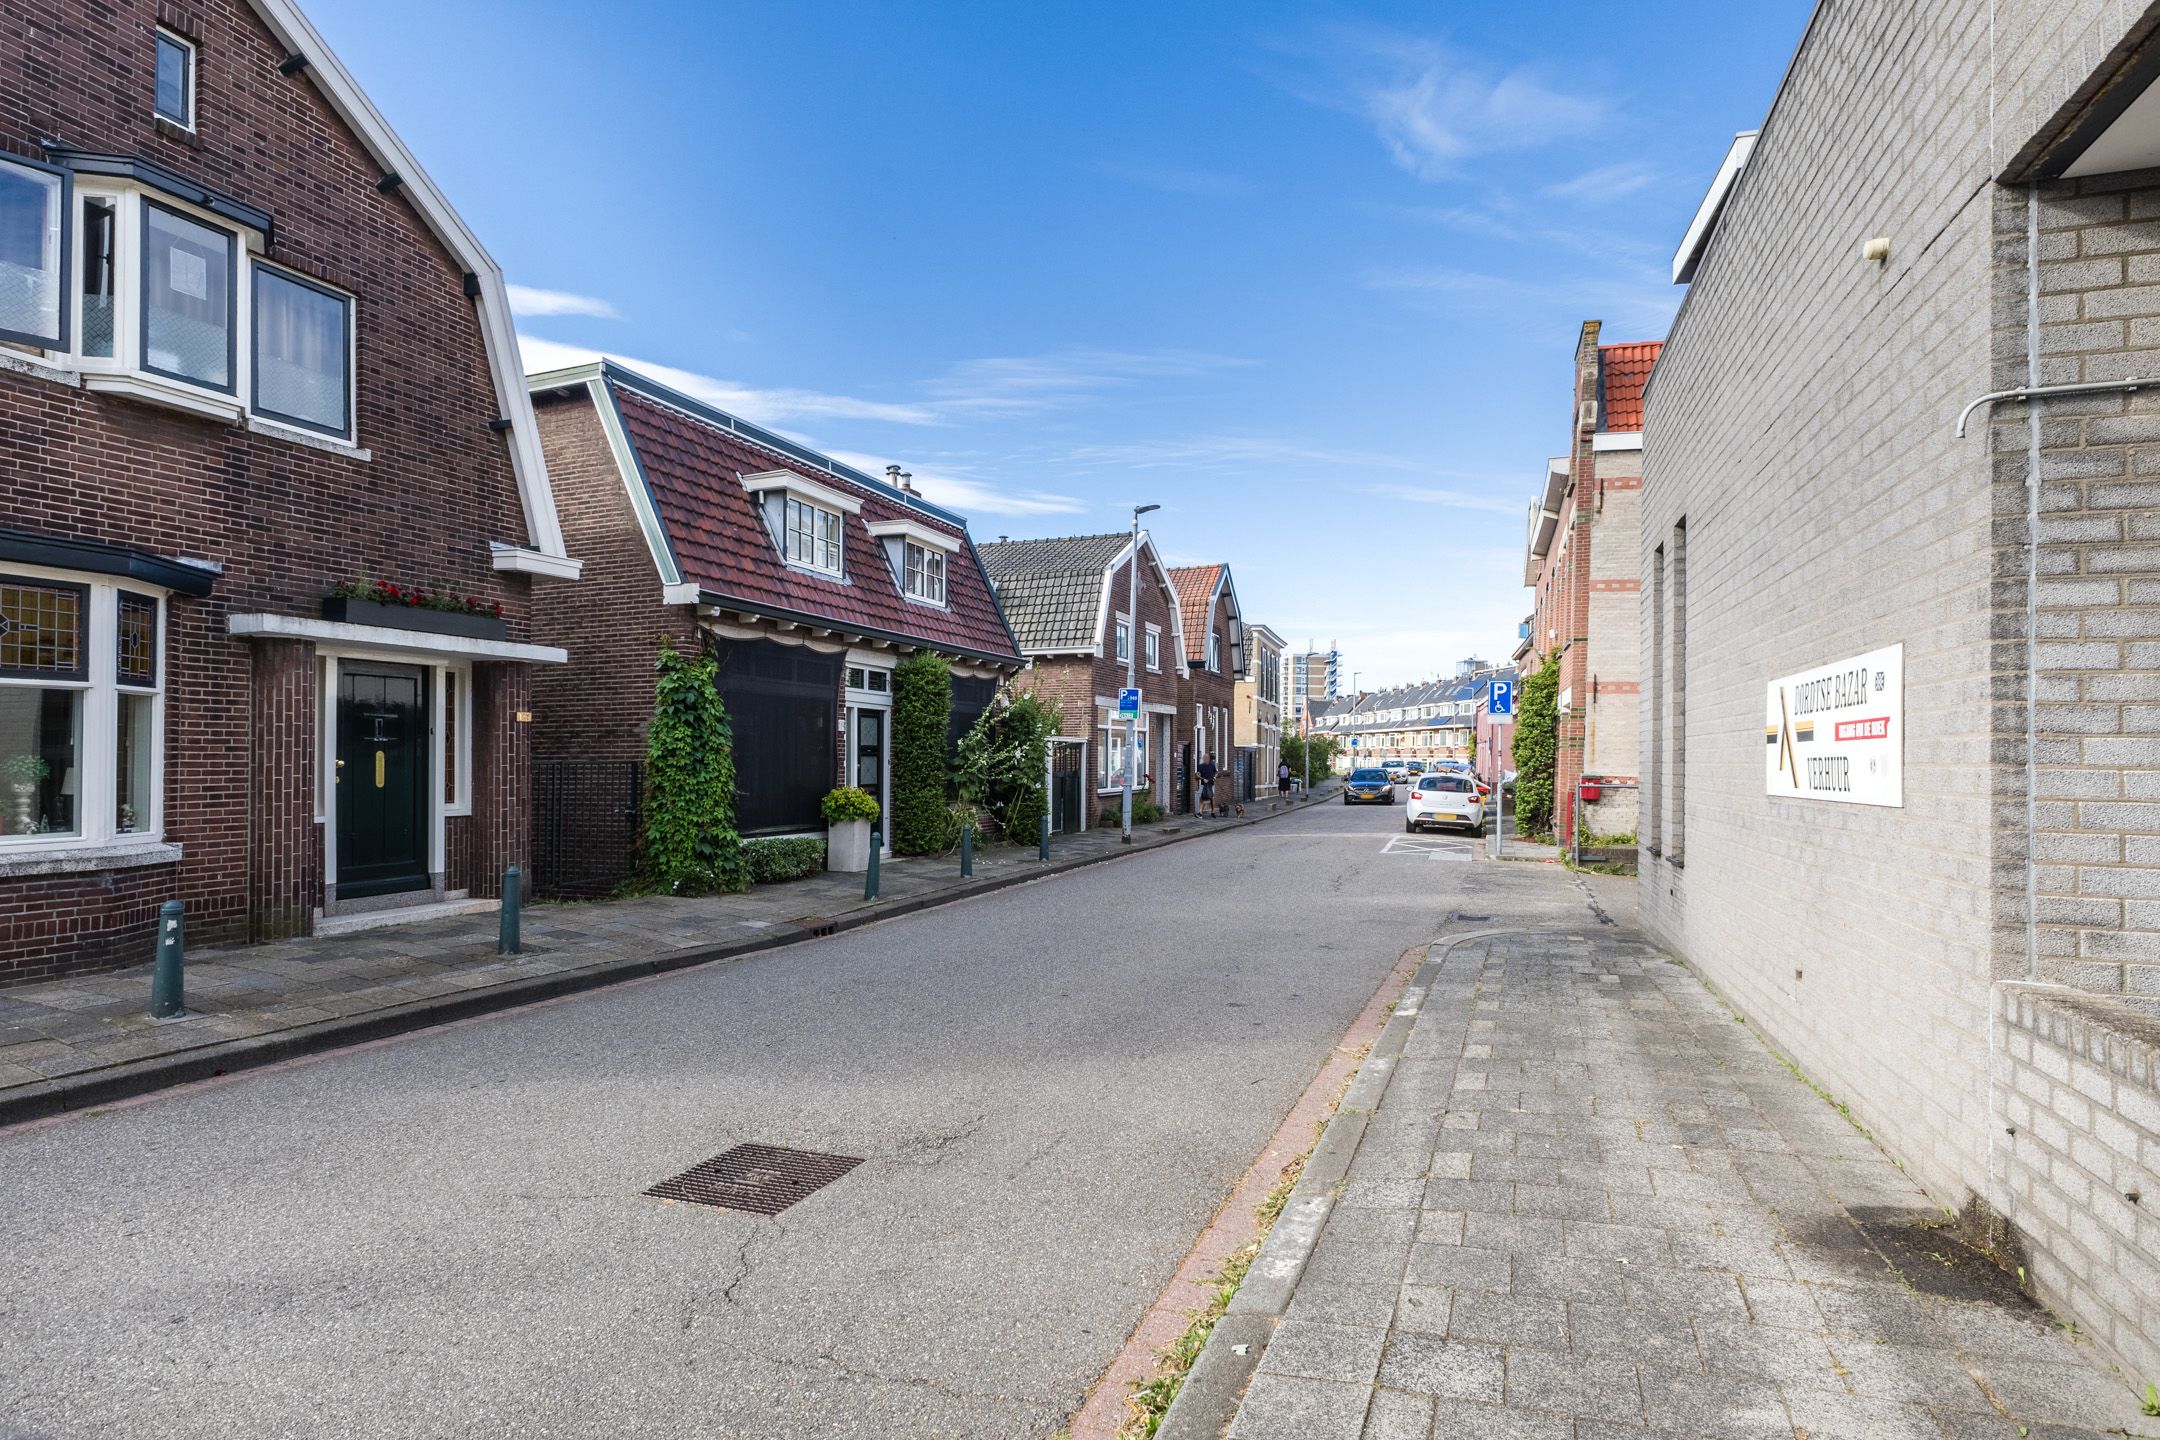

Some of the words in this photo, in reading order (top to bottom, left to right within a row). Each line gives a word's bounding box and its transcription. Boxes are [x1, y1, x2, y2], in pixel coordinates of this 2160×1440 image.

[1120, 690, 1128, 700] P
[1493, 683, 1507, 700] P
[1794, 676, 1832, 716] DORDTSE
[1834, 668, 1868, 709] BAZAR
[1807, 756, 1850, 793] VERHUUR
